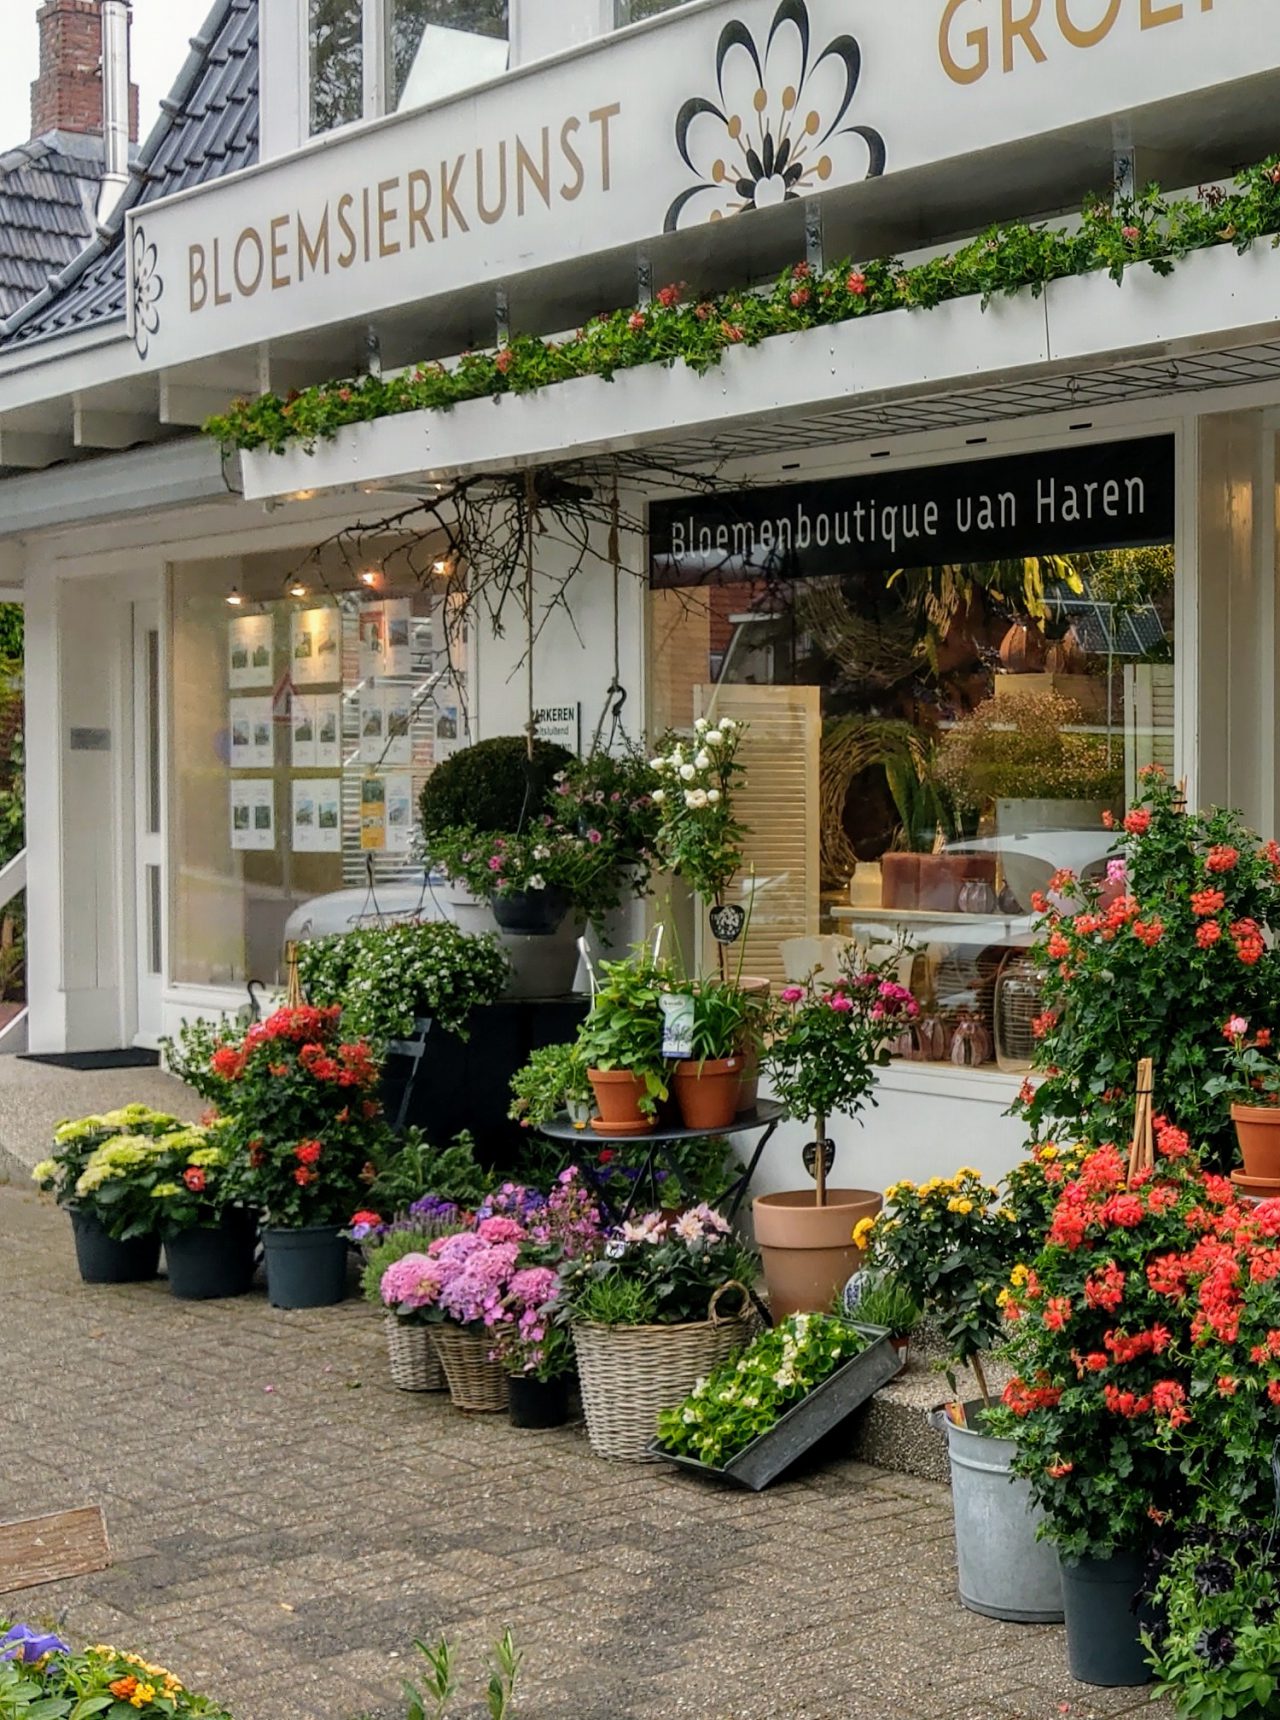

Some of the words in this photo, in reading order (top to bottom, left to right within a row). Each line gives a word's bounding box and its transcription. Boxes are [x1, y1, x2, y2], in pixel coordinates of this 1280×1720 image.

[188, 103, 622, 314] BLOEMSIERKUNST
[672, 500, 939, 561] Bloemenboutique
[1036, 477, 1145, 524] Haren
[533, 707, 575, 721] ARKEREN
